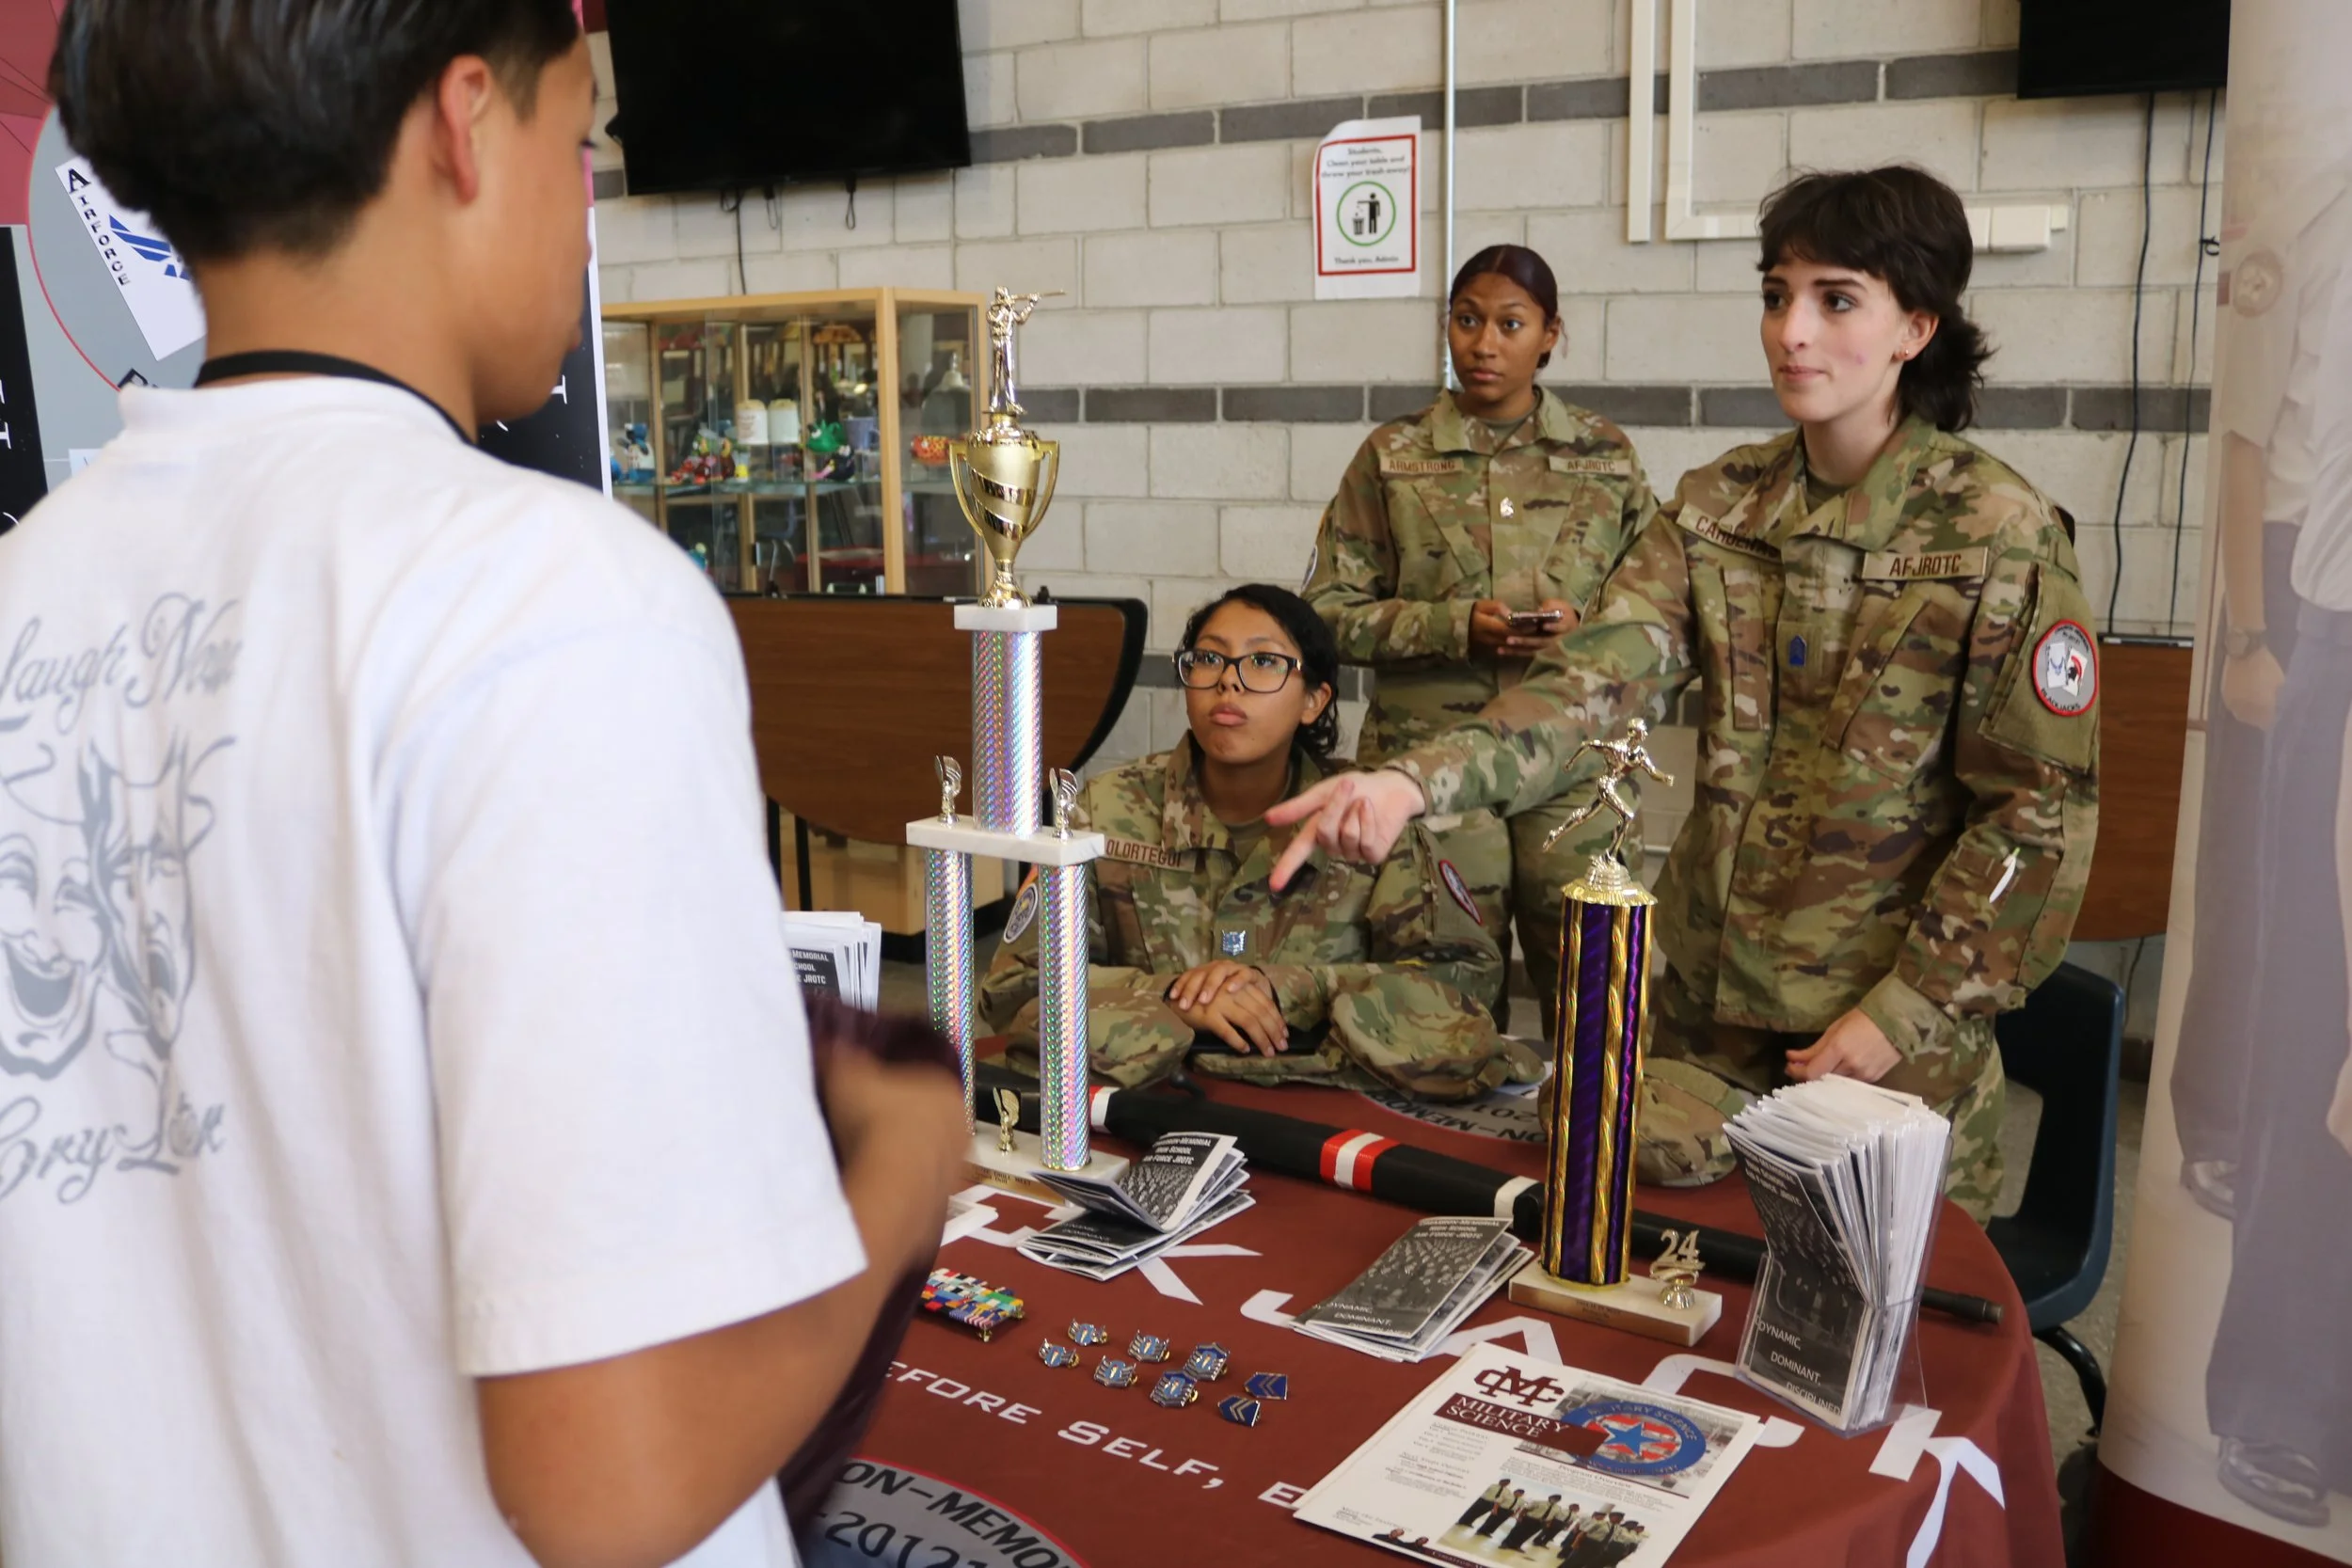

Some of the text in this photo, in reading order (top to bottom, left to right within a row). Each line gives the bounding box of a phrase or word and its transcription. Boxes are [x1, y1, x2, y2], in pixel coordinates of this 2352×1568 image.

[1389, 459, 1455, 471] ARMSTRONG
[1566, 459, 1616, 471] AFJROTC
[1889, 553, 1962, 577] AFJROTC
[791, 949, 829, 961] MEMORIAL
[793, 962, 817, 973] CHOOL
[803, 974, 826, 985] JROTC
[1657, 1228, 1701, 1262] 24
[1758, 1321, 1802, 1352] DYNAMIC,
[1771, 1350, 1822, 1386] DOMINANT,
[1446, 1405, 1544, 1438] SCIENCE
[1456, 1396, 1570, 1433] MILITARY
[1057, 1419, 1224, 1489] SELF,
